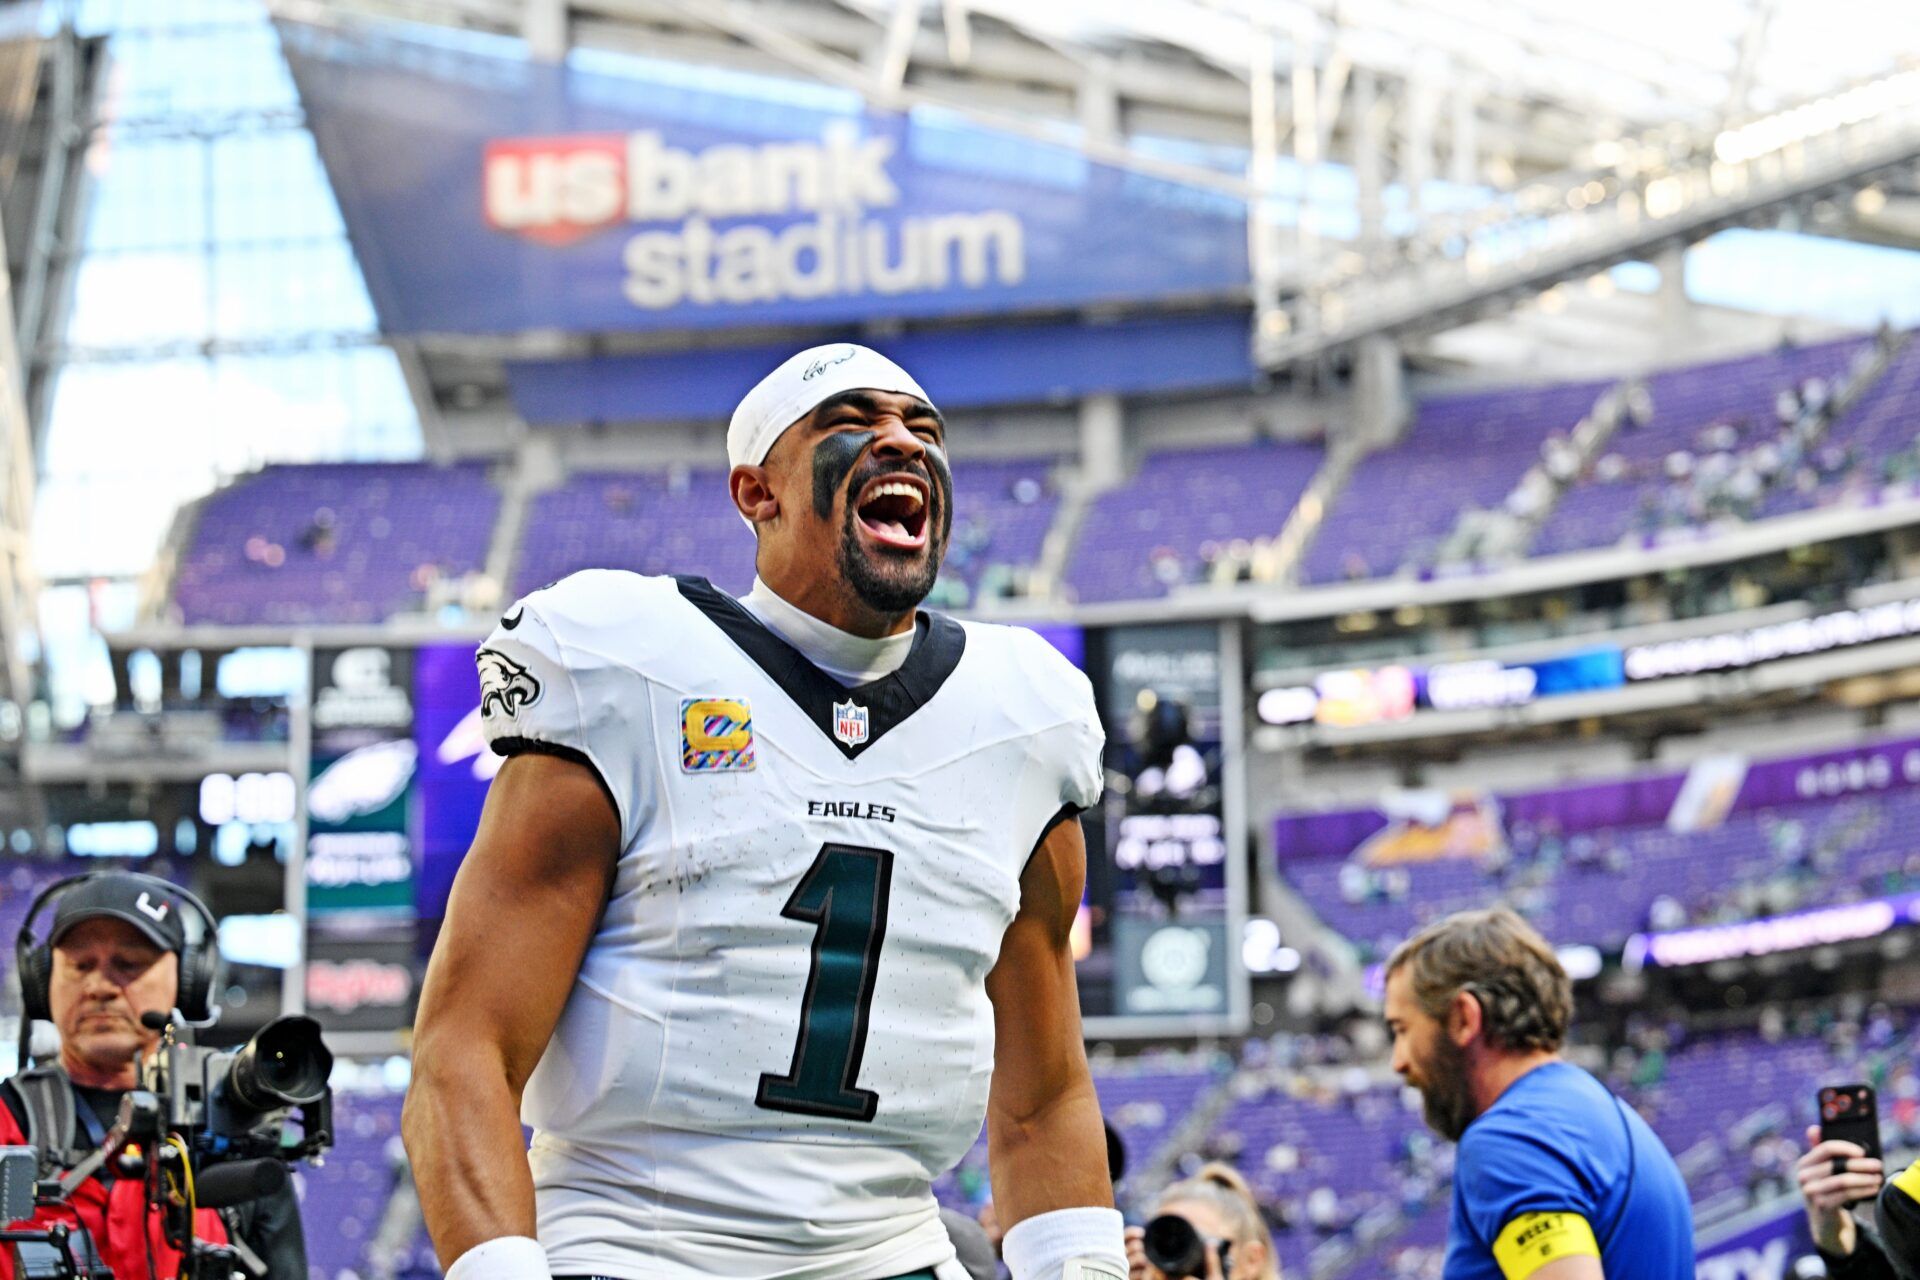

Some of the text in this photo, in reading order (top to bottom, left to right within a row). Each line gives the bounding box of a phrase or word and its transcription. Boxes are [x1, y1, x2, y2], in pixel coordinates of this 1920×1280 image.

[623, 208, 1026, 310] stadium
[839, 719, 865, 738] NFL
[807, 800, 897, 823] EAGLES
[754, 841, 895, 1123] 1
